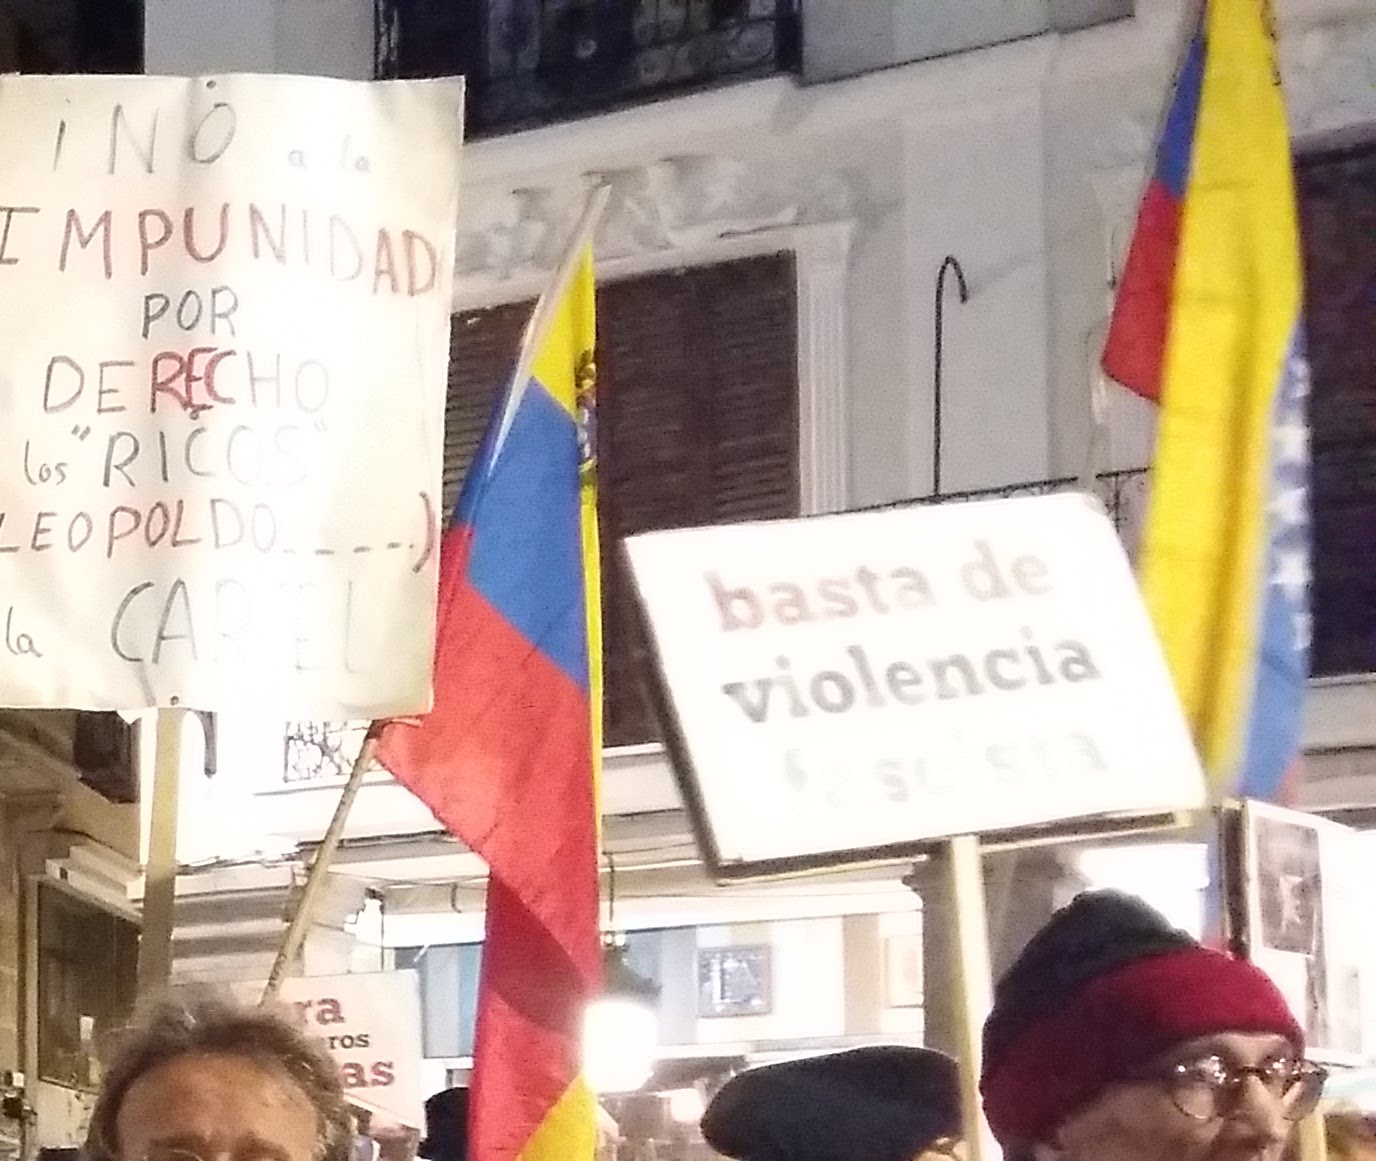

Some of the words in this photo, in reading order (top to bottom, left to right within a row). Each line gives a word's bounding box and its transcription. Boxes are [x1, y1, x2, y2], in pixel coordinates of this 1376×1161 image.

[141, 284, 239, 339] POR
[43, 346, 330, 413] DERECHO
[24, 440, 68, 485] los
[704, 563, 937, 633] basta
[959, 538, 1056, 603] de
[5, 606, 43, 658] la
[110, 575, 375, 677] CAREL
[721, 625, 1103, 724] violencia
[295, 998, 346, 1026] ra
[328, 1033, 370, 1050] ros
[340, 1061, 396, 1088] as
